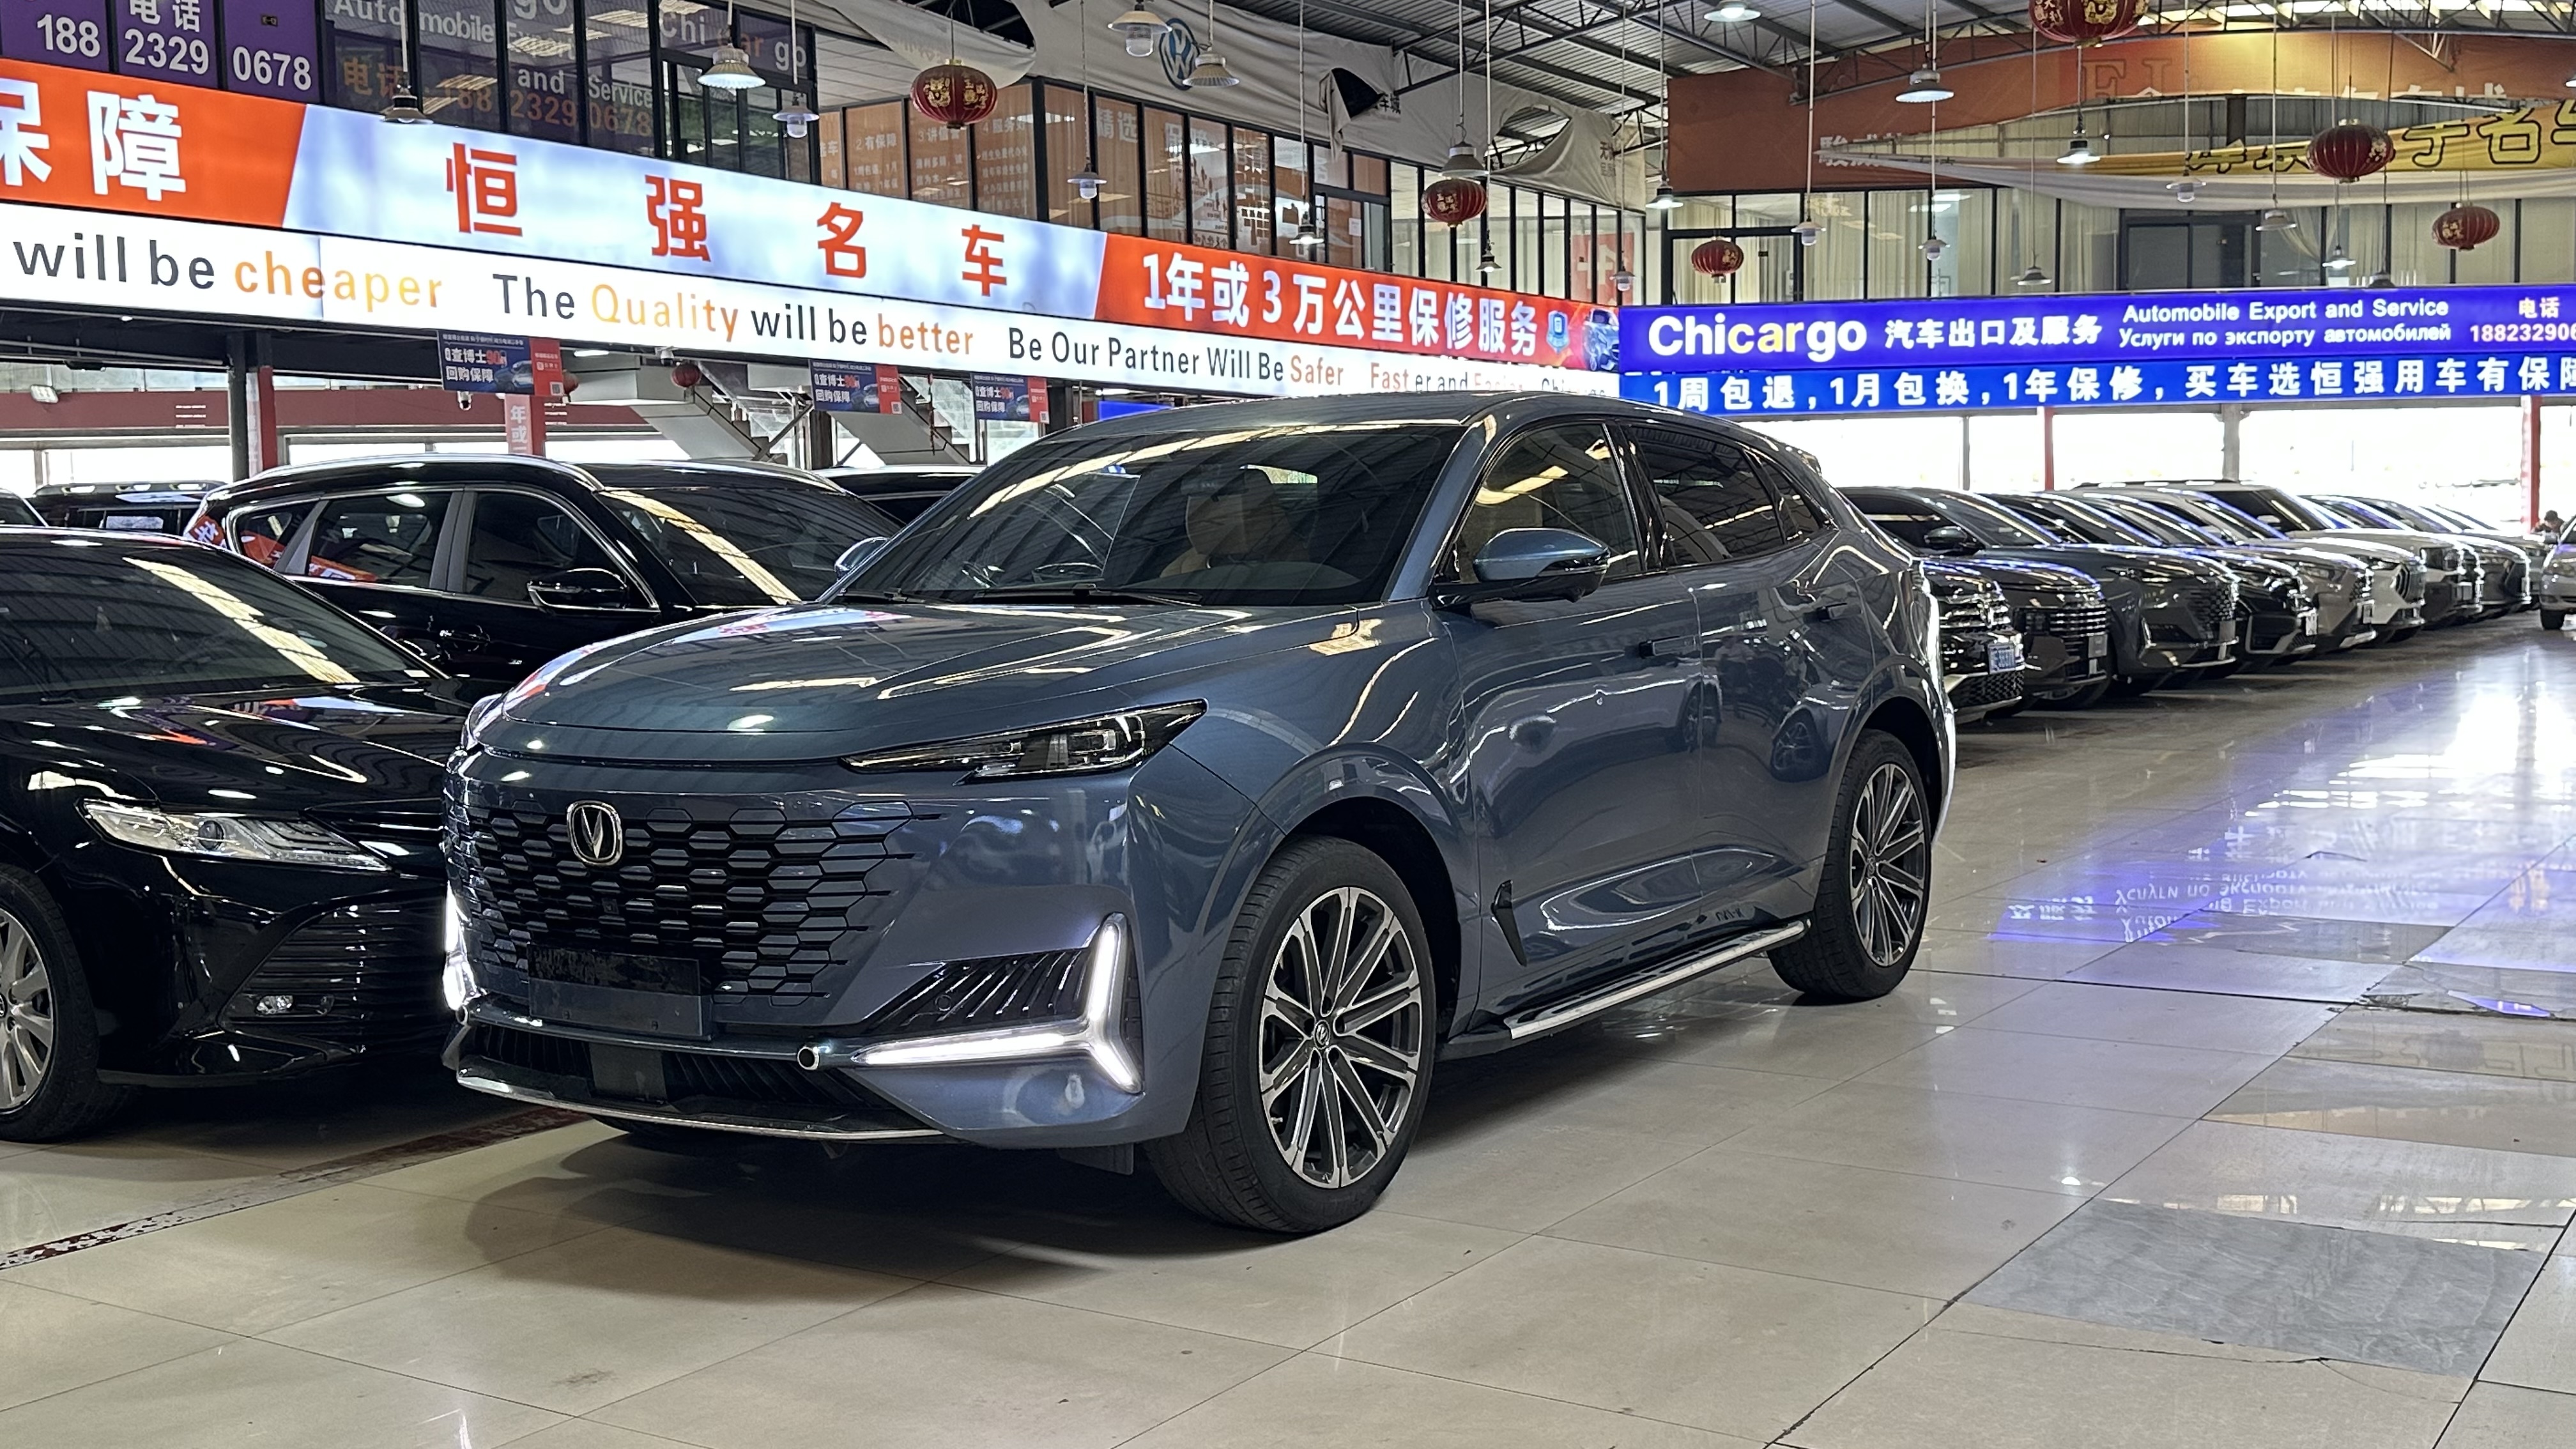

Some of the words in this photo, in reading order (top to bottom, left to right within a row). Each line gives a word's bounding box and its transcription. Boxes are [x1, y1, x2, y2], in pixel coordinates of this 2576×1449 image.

[130, 0, 200, 32] 电话
[36, 14, 100, 57] 188
[125, 29, 209, 75] 2329
[233, 46, 312, 91] 0678
[518, 68, 565, 95] and
[588, 74, 653, 108] Service
[510, 89, 576, 126] 2329
[589, 102, 652, 137] 0678
[446, 142, 1008, 296] 恒强名车
[13, 233, 127, 283] will
[150, 239, 215, 289] be
[234, 250, 442, 312] cheaper
[492, 273, 576, 319] The
[592, 284, 739, 342] Quality
[751, 303, 816, 341] will
[829, 308, 868, 344] be
[878, 313, 974, 355] better
[1009, 326, 1041, 362] Be
[1051, 330, 1099, 365] Our
[1108, 337, 1200, 375] Partner
[1207, 347, 1250, 379] Will
[1259, 353, 1284, 381] Be
[1290, 355, 1344, 386] Safer
[2123, 303, 2240, 323] Automobile
[2249, 301, 2317, 322] Export
[2325, 300, 2364, 318] and
[2372, 298, 2449, 318] Service
[2518, 296, 2560, 319] 电话
[1649, 313, 1867, 362] Chicargo
[1885, 314, 2103, 349] 汽车出口及服务
[2119, 327, 2185, 349] Услуги
[2191, 330, 2218, 346] по
[2225, 328, 2315, 347] экспорту
[2324, 323, 2451, 343] автомобилей
